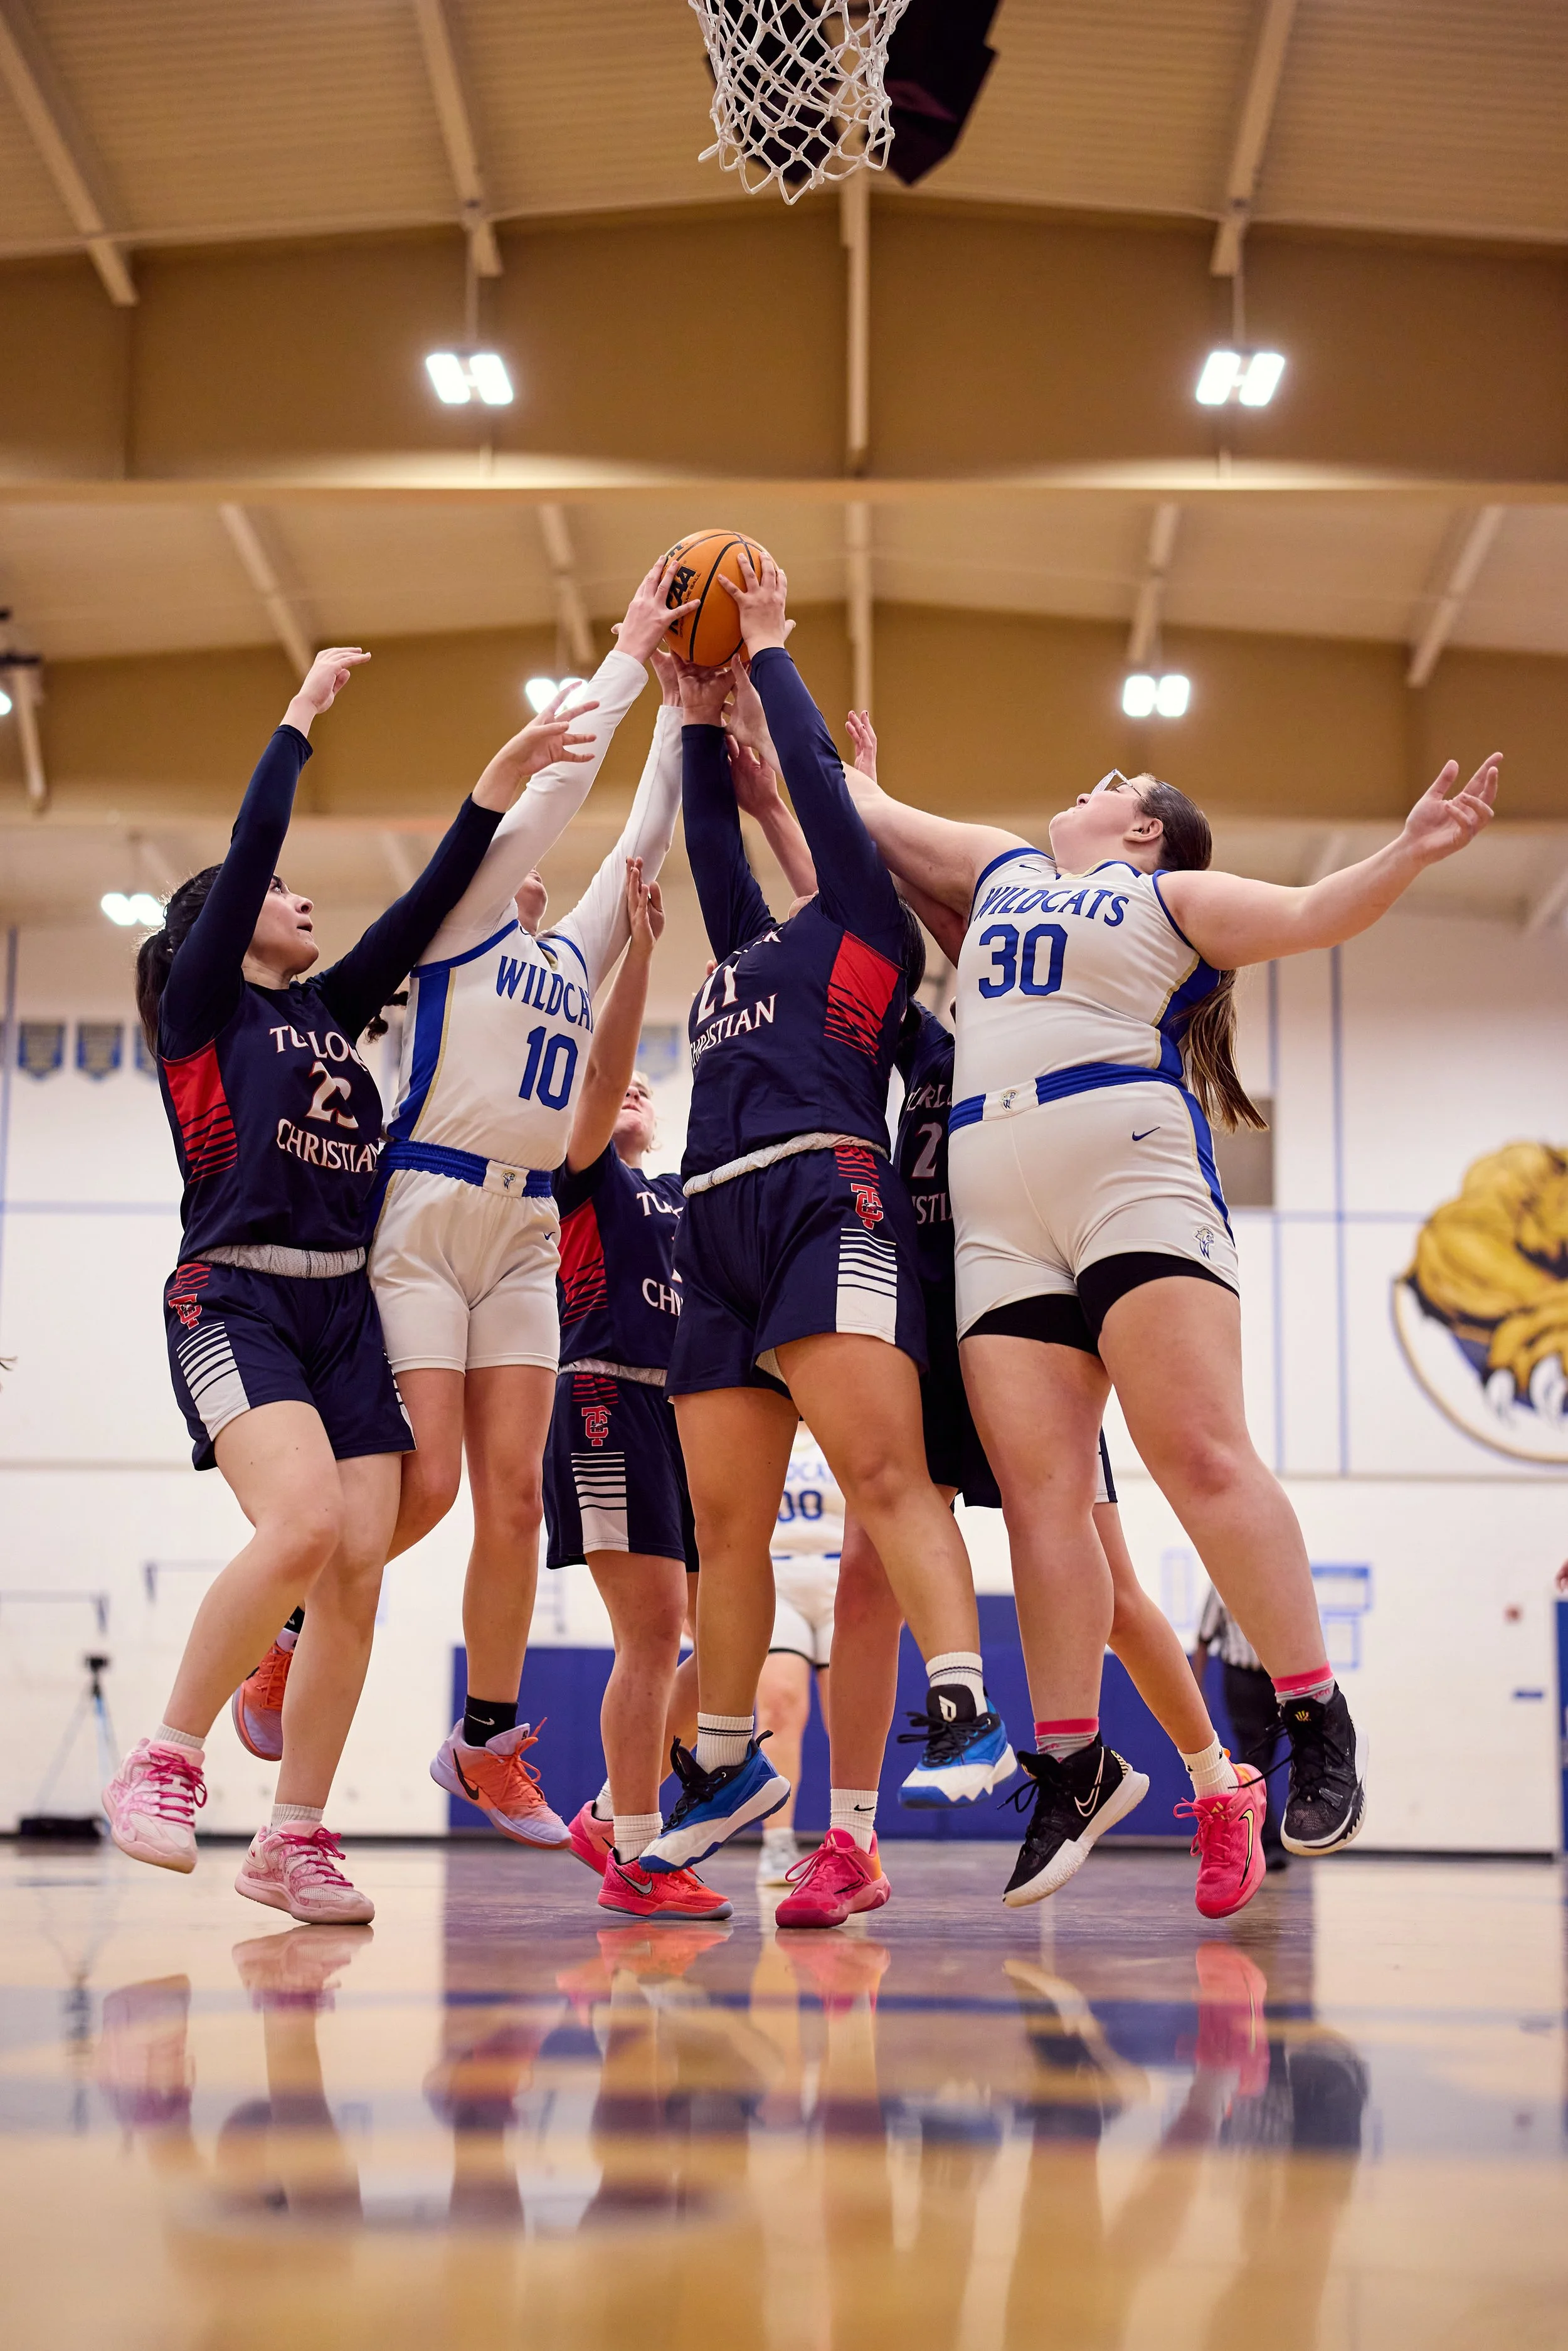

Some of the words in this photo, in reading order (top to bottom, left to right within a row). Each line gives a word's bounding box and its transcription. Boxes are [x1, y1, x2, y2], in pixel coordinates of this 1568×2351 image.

[974, 886, 1130, 927] WILDCATS
[496, 955, 593, 1034] WILDCA
[978, 923, 1068, 999] 30
[518, 1026, 578, 1111] 10
